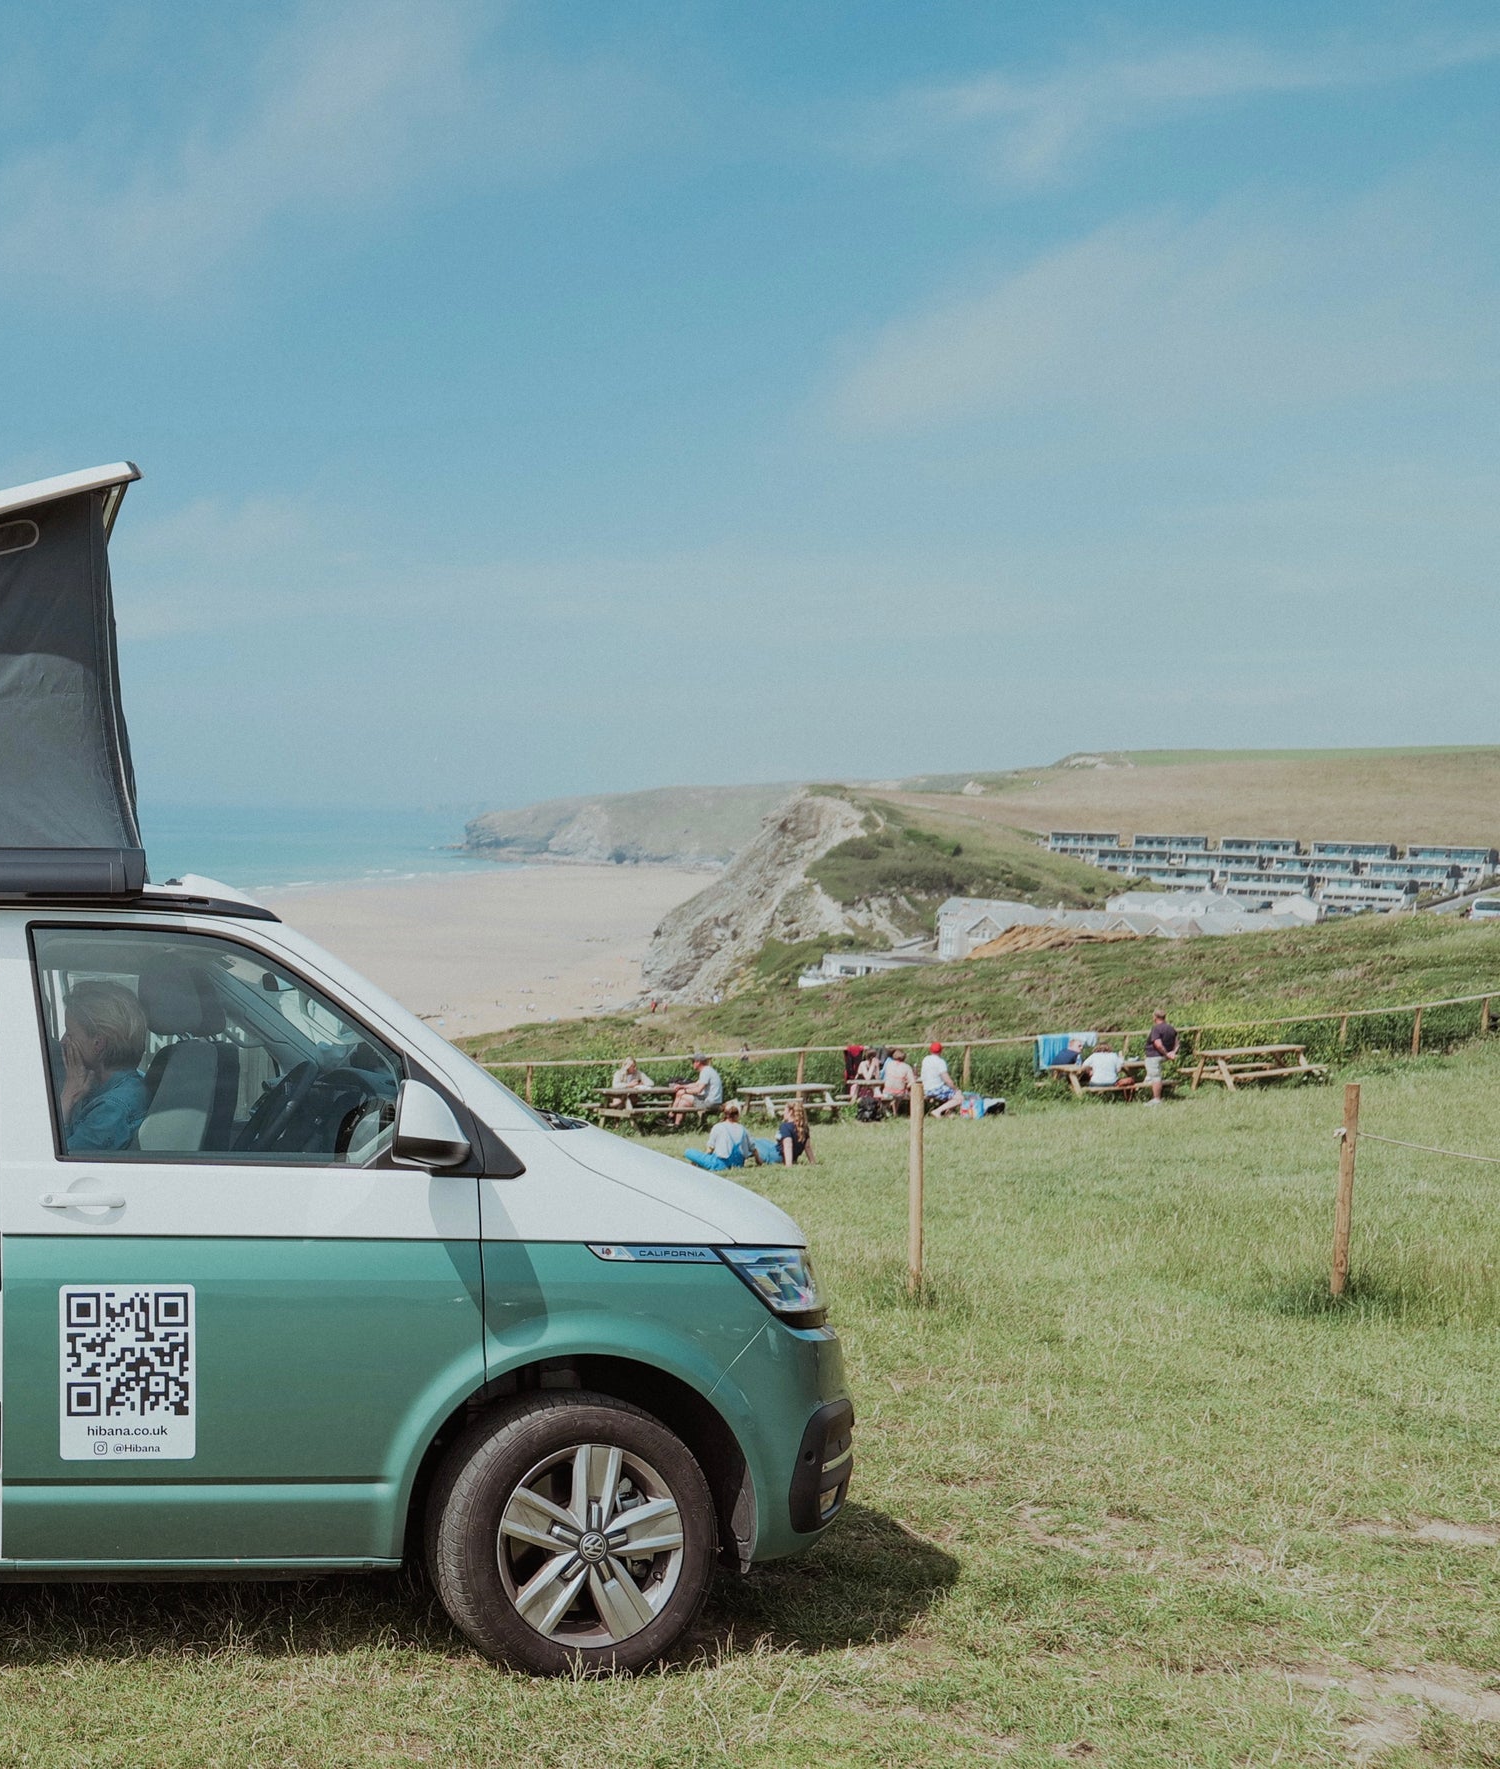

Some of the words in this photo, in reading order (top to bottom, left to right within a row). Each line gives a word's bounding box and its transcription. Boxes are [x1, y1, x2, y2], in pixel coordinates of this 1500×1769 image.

[638, 1249, 706, 1258] CALIFORNIA
[87, 1425, 168, 1437] hibana.co.uk
[113, 1443, 161, 1455] @Hibana
